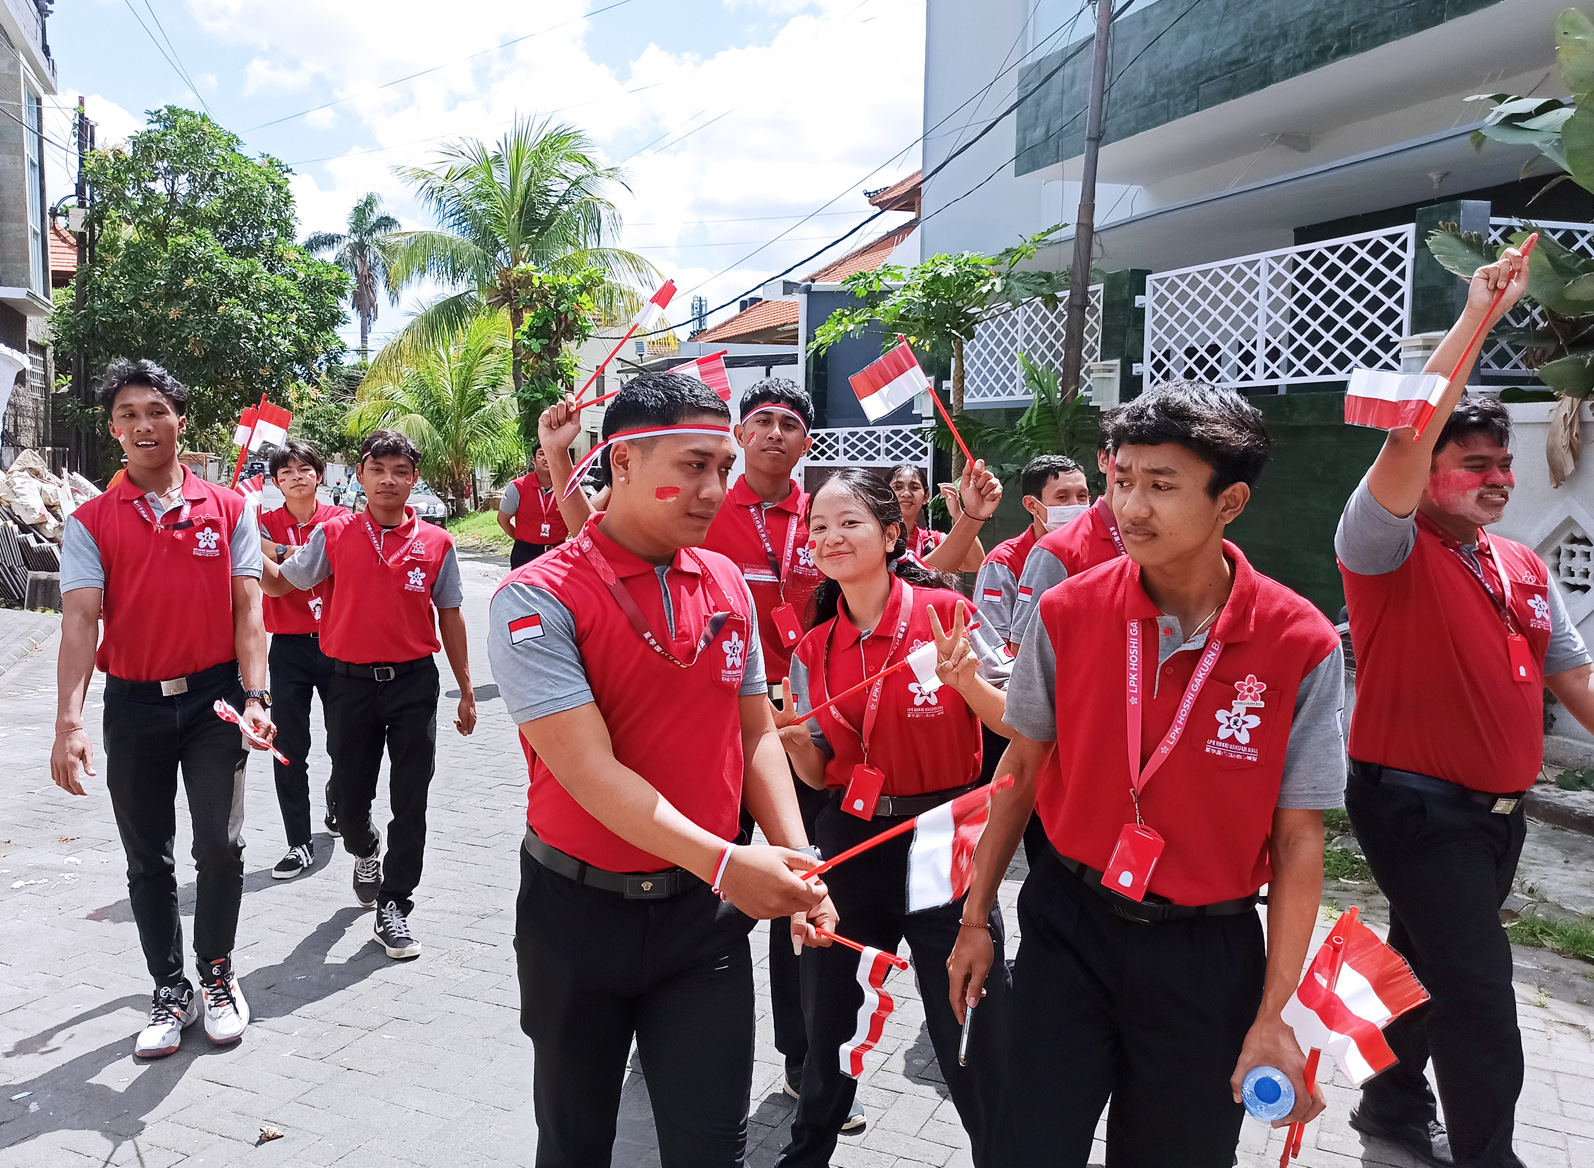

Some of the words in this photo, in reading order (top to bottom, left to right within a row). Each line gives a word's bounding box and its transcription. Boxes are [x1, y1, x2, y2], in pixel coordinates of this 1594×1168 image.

[1130, 639, 1138, 671] HOSHI
[1130, 677, 1138, 693] LPK
[1166, 726, 1182, 745] LPK
[1178, 692, 1196, 725] HOSHI
[1191, 651, 1217, 692] GAKUEN
